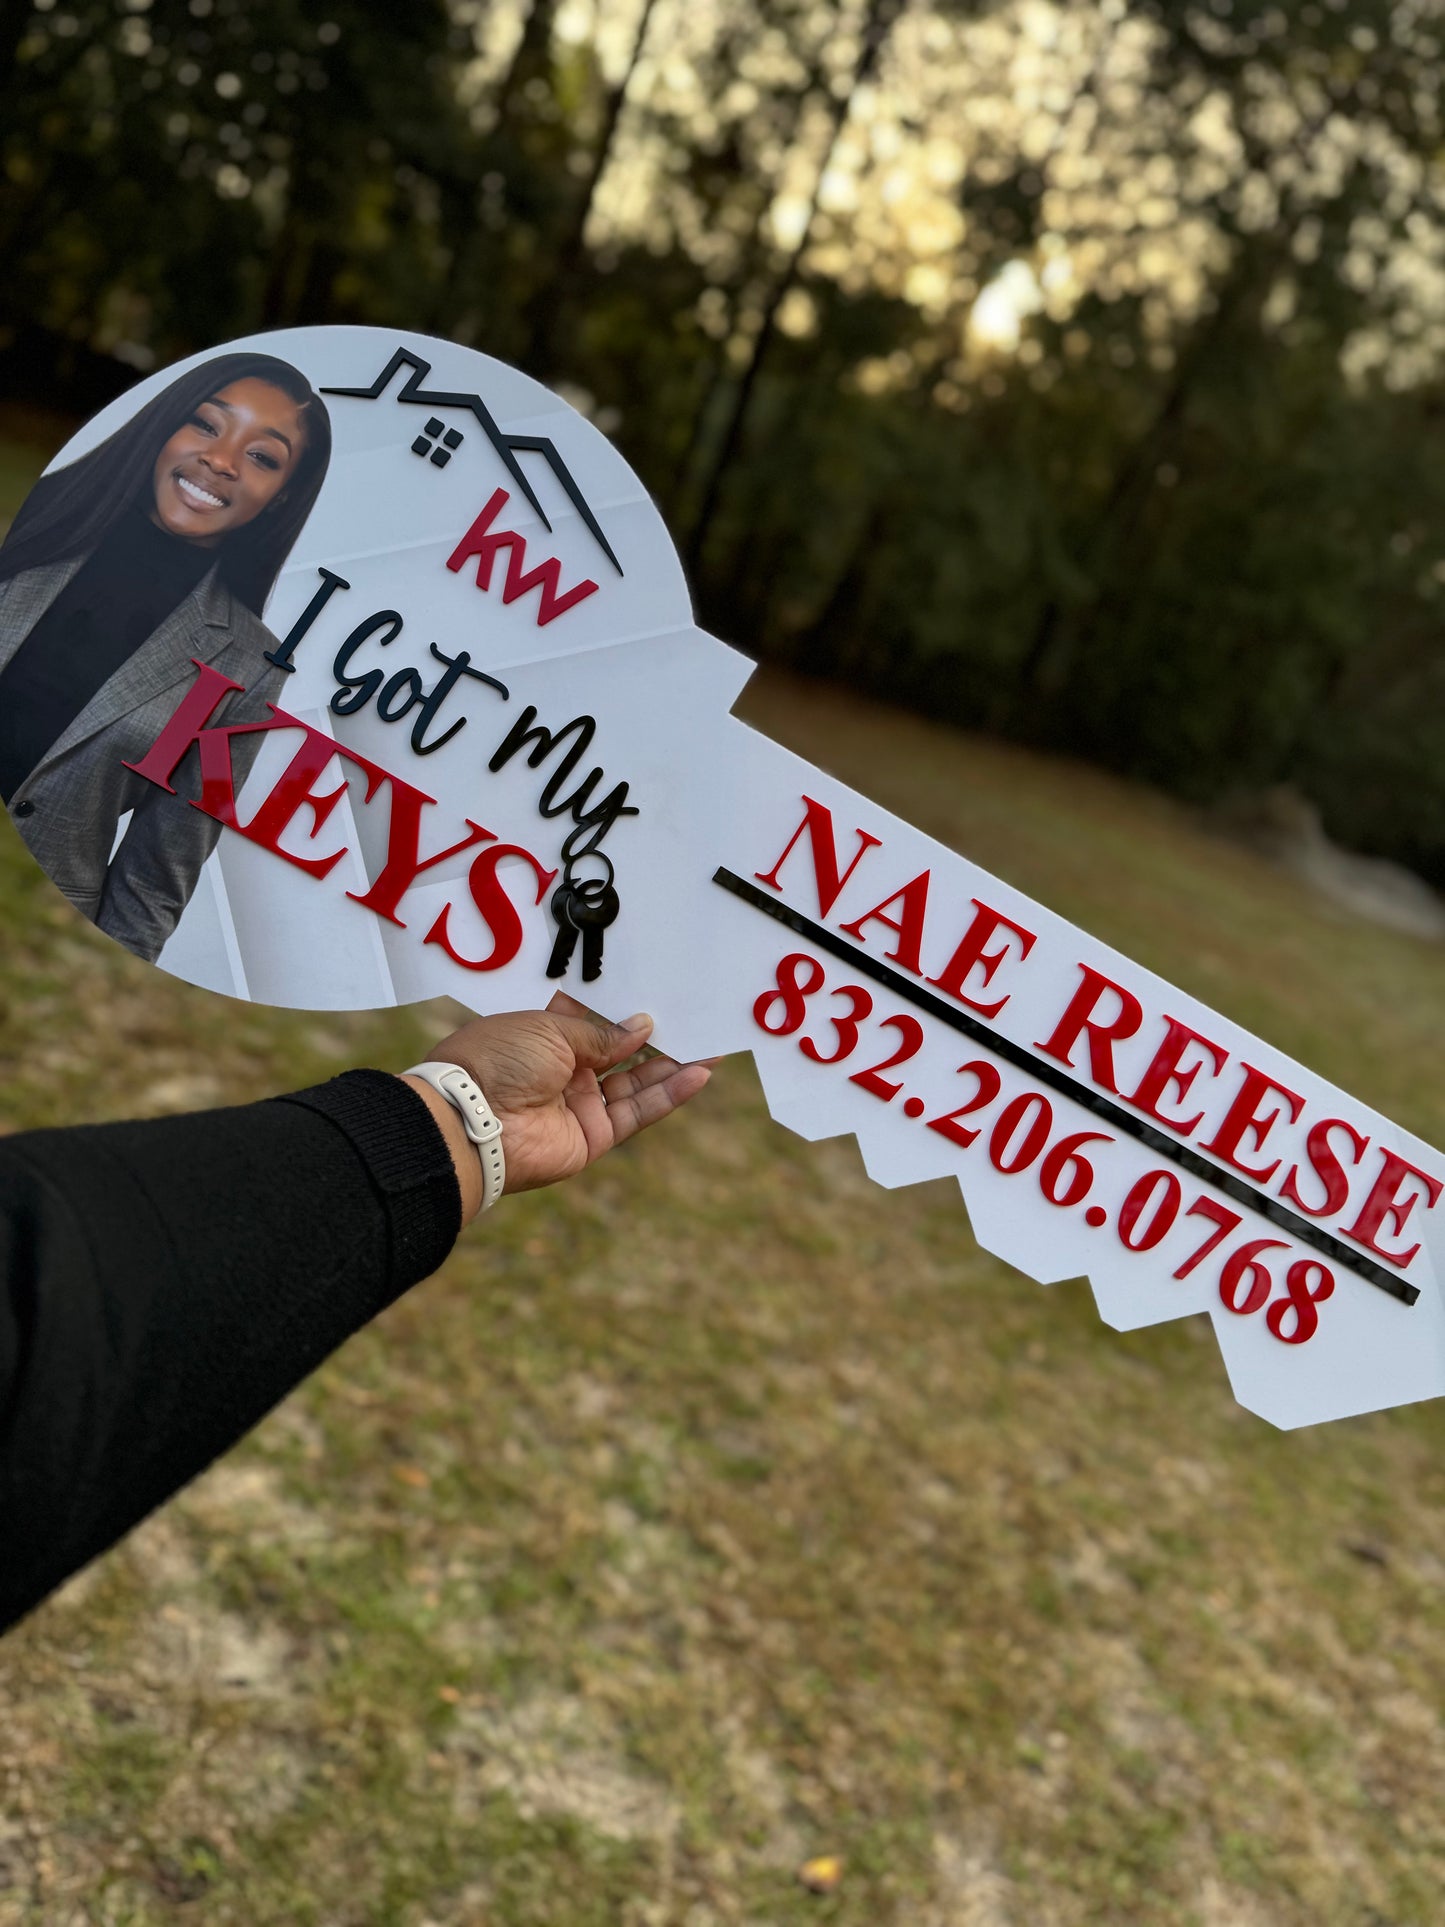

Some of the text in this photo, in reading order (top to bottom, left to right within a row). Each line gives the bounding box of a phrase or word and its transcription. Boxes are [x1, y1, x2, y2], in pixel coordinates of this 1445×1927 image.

[121, 658, 559, 972] KEYS
[264, 567, 350, 673] I
[330, 609, 510, 755] Got
[752, 952, 1335, 1345] 832.206.0768
[754, 794, 1444, 1270] NAE REESE
